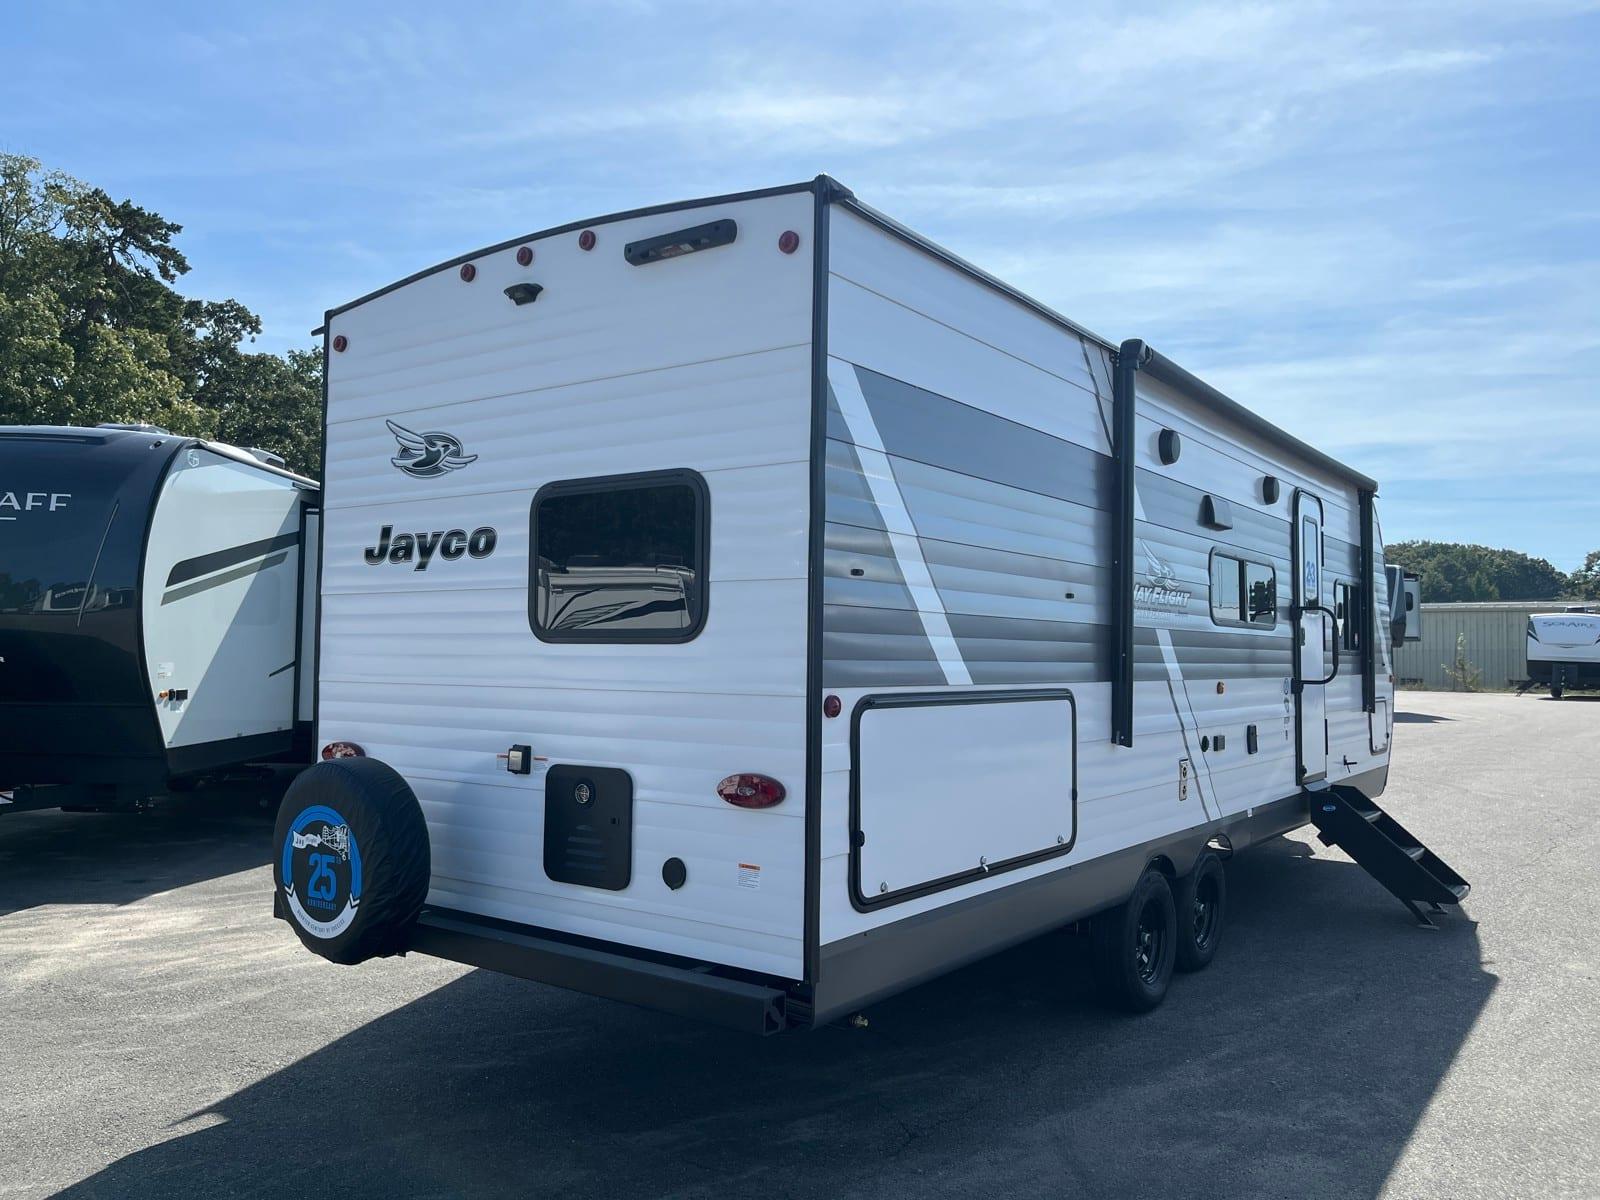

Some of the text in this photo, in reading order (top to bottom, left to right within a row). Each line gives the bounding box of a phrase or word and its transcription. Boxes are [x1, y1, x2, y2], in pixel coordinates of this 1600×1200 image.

[364, 524, 498, 571] Jayco
[1152, 587, 1190, 606] FLIGHT
[308, 852, 337, 901] 25
